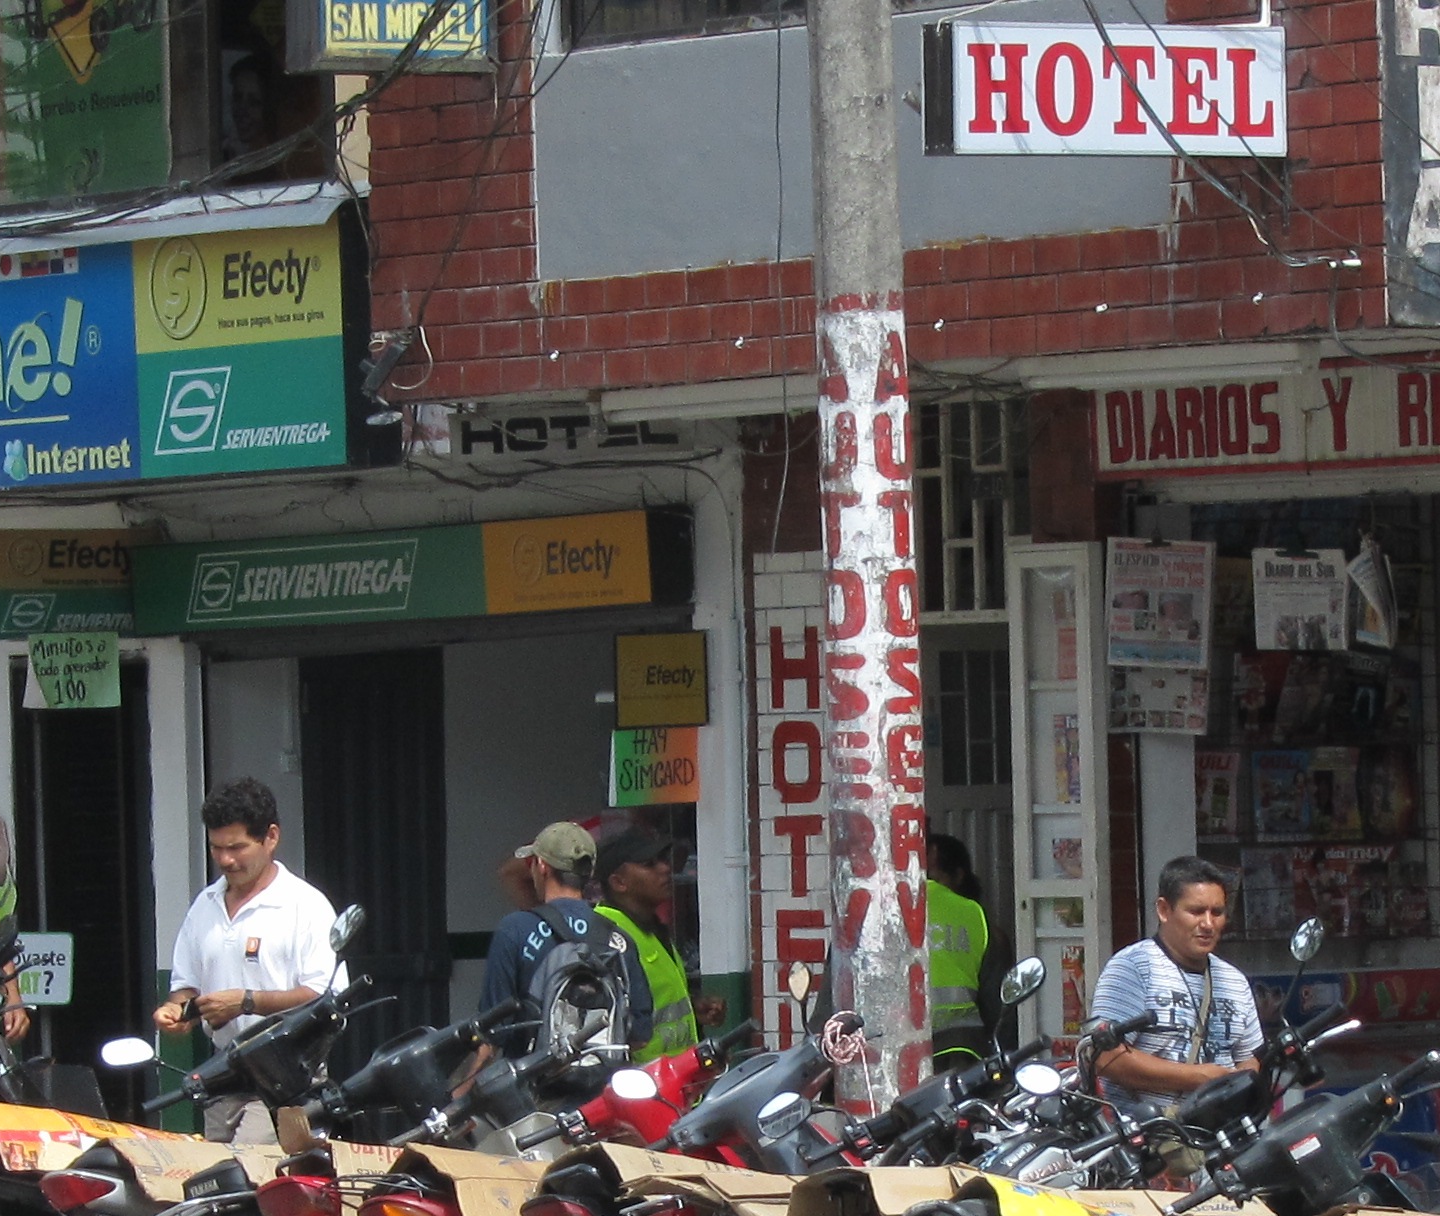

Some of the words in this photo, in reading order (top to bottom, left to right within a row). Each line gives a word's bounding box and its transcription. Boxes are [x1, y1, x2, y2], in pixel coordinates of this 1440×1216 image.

[967, 42, 1275, 138] HOTEL
[221, 247, 313, 305] Efecty
[221, 422, 330, 451] SERVIENTREGA
[1107, 380, 1281, 465] DIARIOS
[1324, 374, 1352, 452] Y
[27, 437, 131, 476] Internet
[237, 556, 411, 603] SERVIENTREGA
[545, 538, 614, 580] Efecty
[54, 679, 86, 705] 100
[645, 664, 696, 689] Efecty
